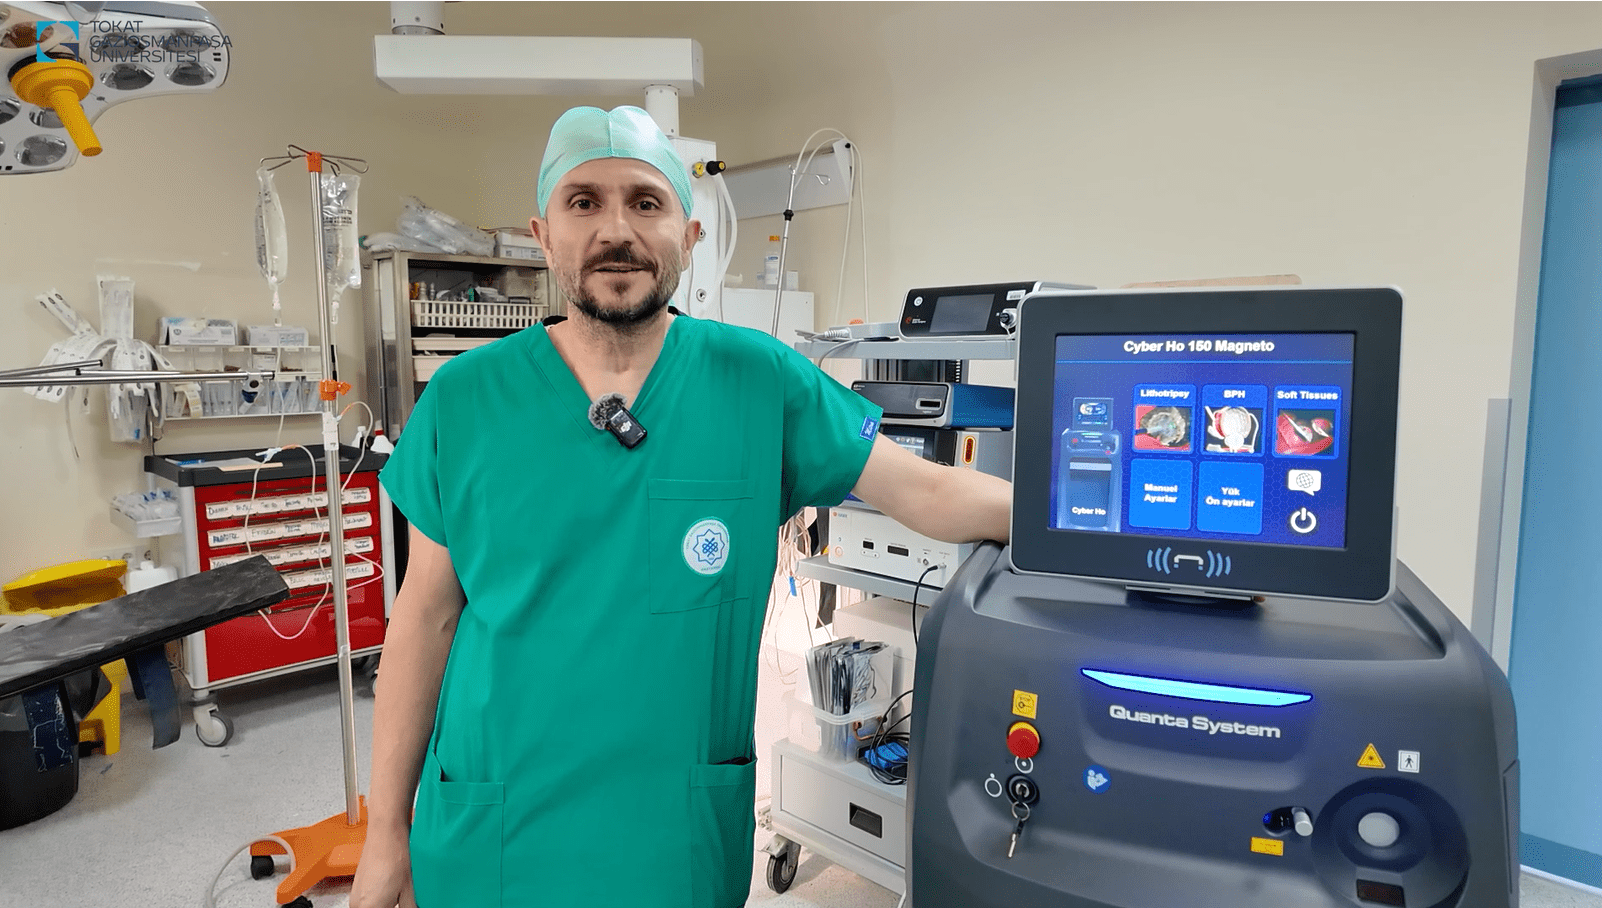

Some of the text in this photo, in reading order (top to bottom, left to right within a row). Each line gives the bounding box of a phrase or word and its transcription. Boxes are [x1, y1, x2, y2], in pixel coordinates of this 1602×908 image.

[1123, 339, 1275, 355] Cyber Ho 150 Magneto
[1140, 389, 1190, 399] Lithotripsy
[1223, 389, 1246, 399] BPH
[1277, 390, 1339, 400] Soft Tissues
[1143, 483, 1178, 493] Manuel
[1220, 486, 1241, 497] Yük
[1143, 494, 1178, 504] Ayarlar
[1222, 498, 1256, 508] ayarlar
[1071, 506, 1107, 516] Cyber Ho
[1109, 704, 1281, 739] Quanta System
